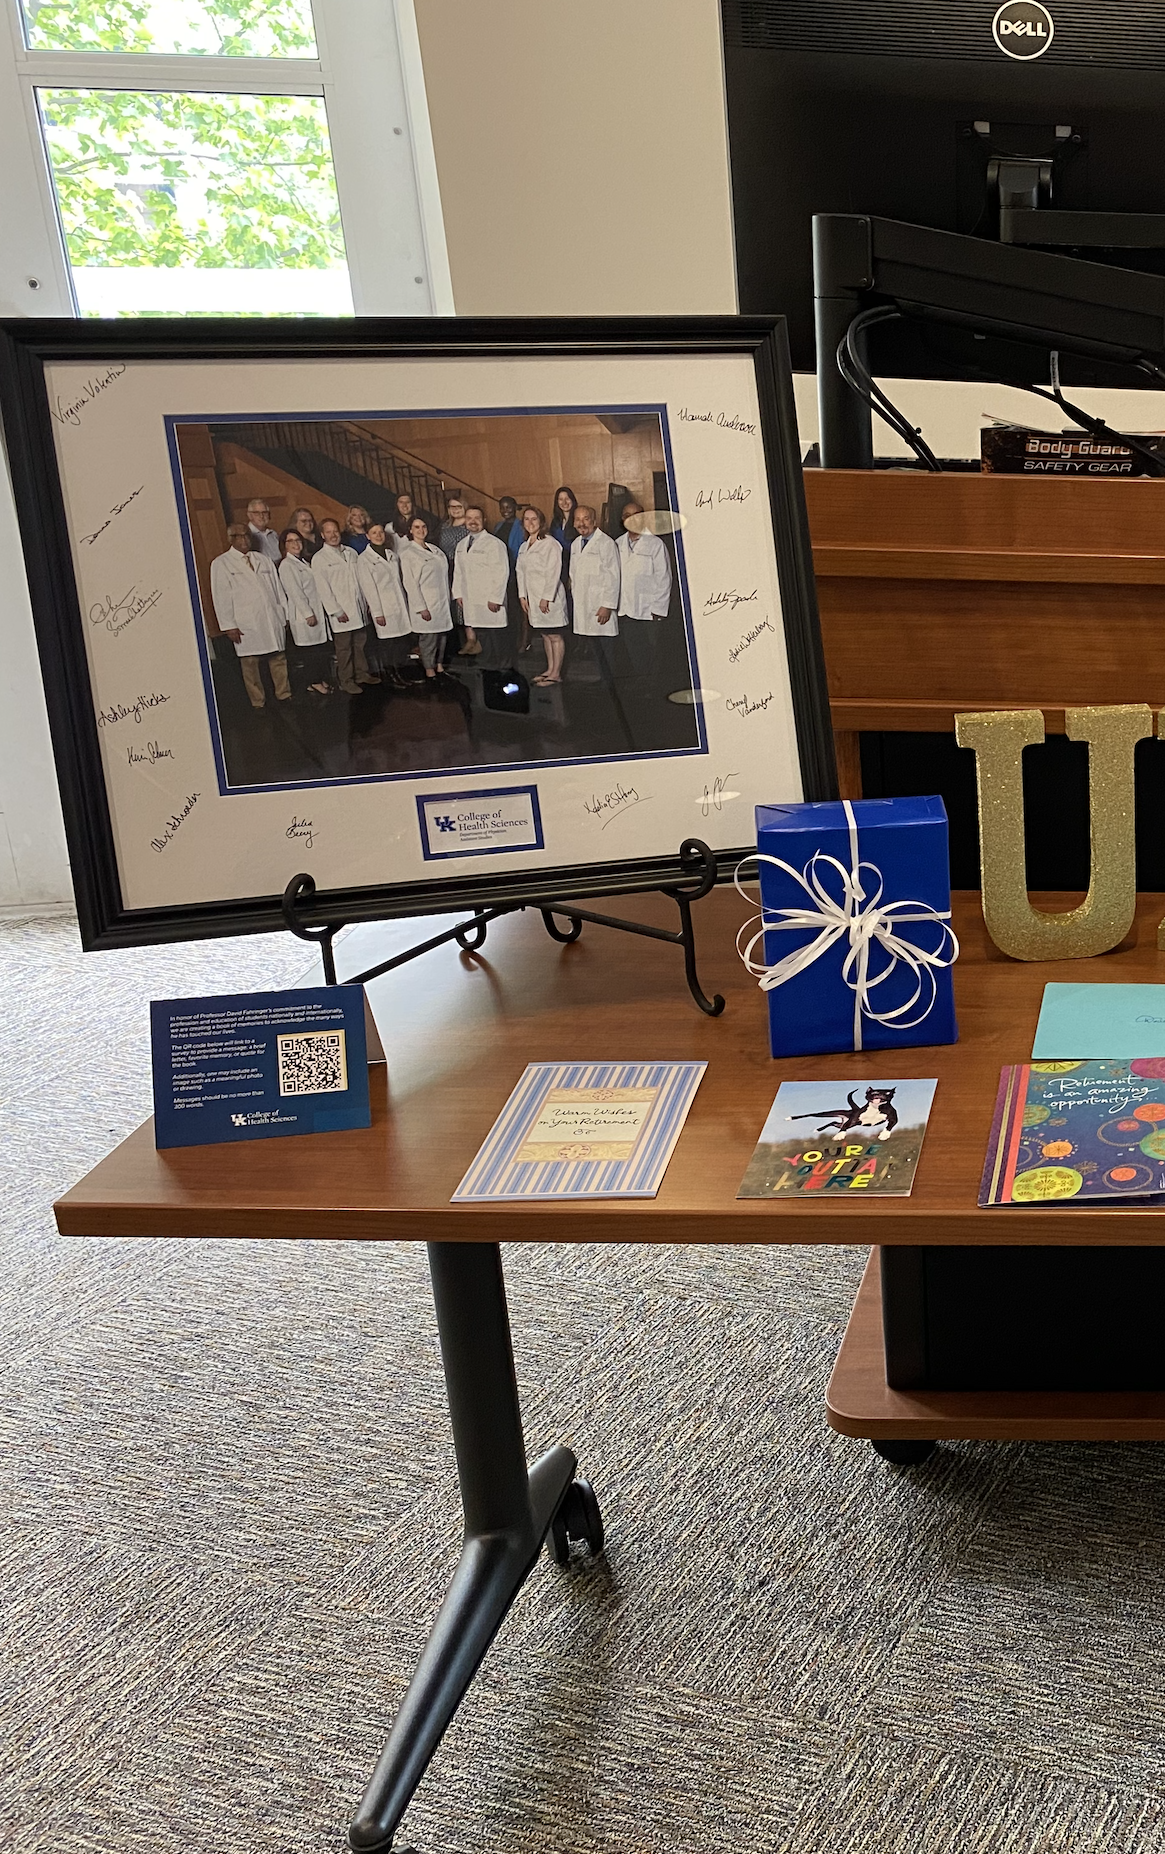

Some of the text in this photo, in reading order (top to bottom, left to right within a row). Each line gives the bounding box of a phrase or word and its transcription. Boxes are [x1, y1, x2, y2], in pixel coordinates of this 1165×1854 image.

[1000, 20, 1047, 37] DELL
[1028, 439, 1072, 459] Body
[1024, 461, 1133, 472] SAFETY GEAR
[458, 809, 502, 822] College of
[458, 818, 528, 831] Health Sciences
[1048, 1075, 1141, 1092] Retirement
[1042, 1089, 1060, 1099] is
[1088, 1085, 1159, 1098] amazing
[247, 1111, 272, 1119] College
[552, 1107, 637, 1117] Warm Wishes
[247, 1115, 297, 1125] Health Sciences
[579, 1117, 640, 1126] Retirement
[797, 1158, 877, 1176] OUTTA
